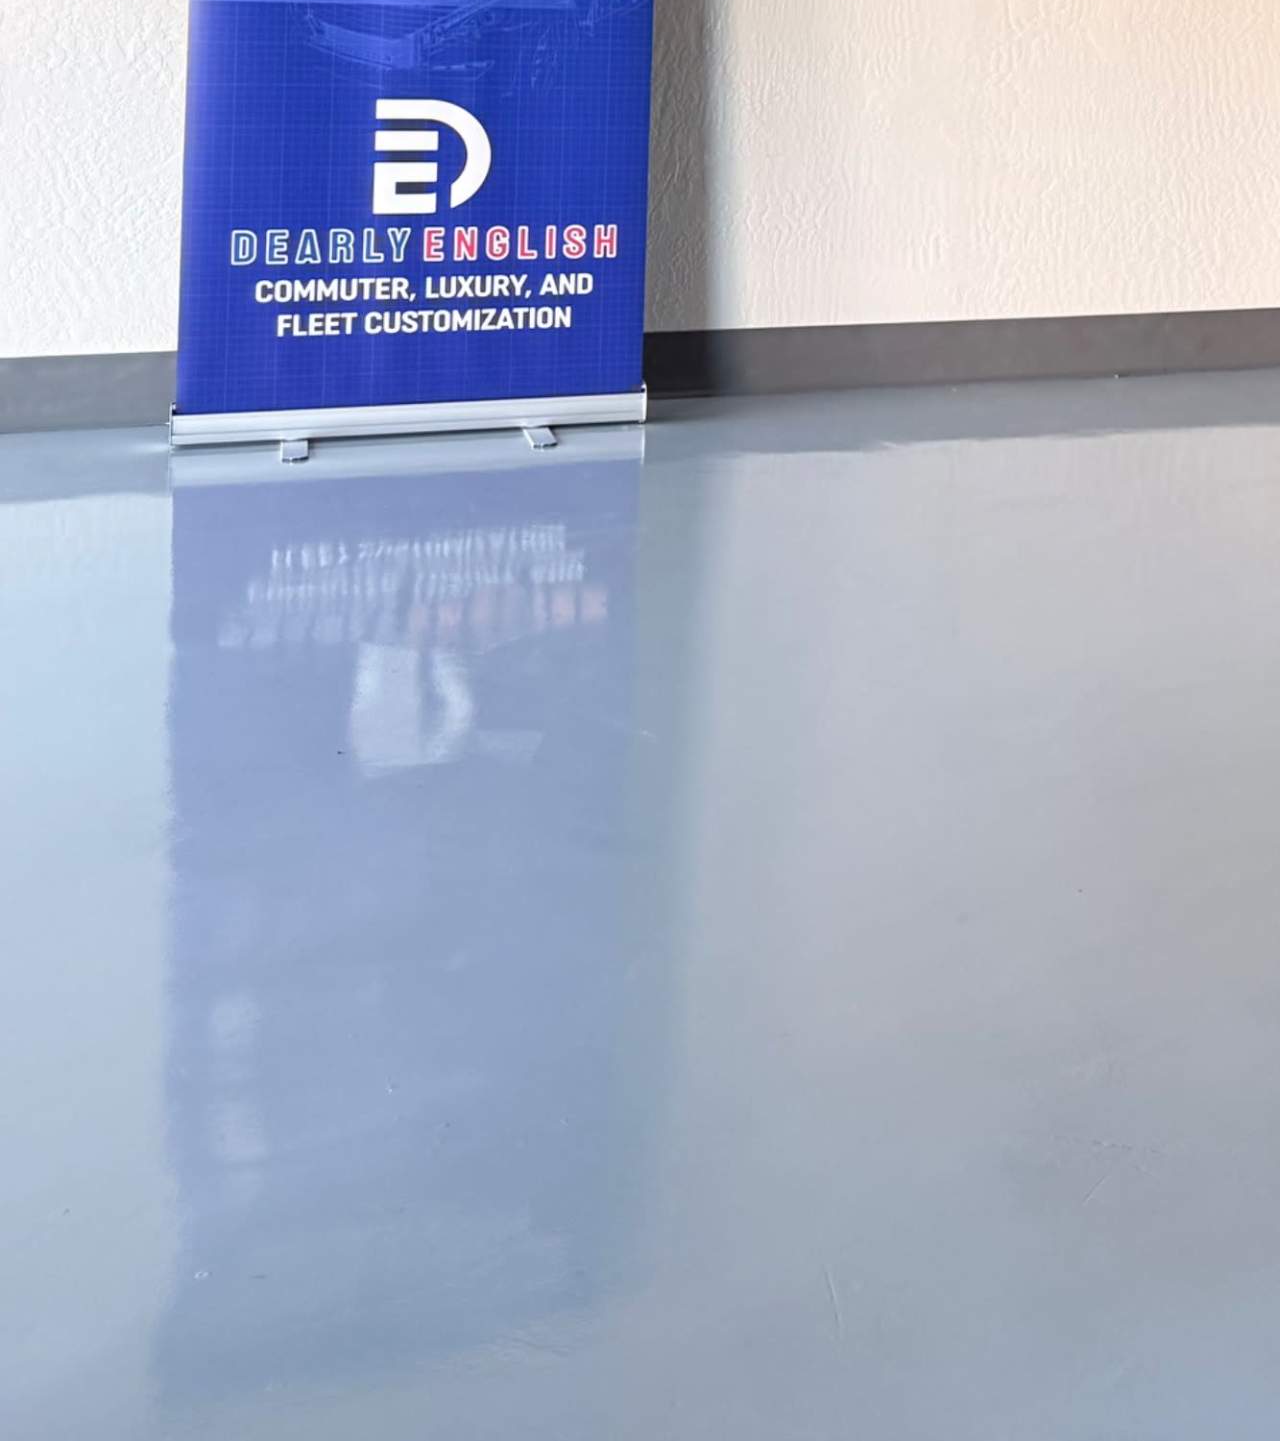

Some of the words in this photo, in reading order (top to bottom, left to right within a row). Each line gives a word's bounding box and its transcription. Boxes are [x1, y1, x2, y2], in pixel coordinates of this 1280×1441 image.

[230, 227, 412, 266] DEARLY
[421, 224, 618, 262] ENGLISH
[254, 278, 416, 305] COMMUTER,
[425, 274, 532, 301] LUXURY,
[539, 273, 594, 297] AND
[276, 310, 358, 338] FLEET
[364, 307, 573, 336] CUSTOMIZATION
